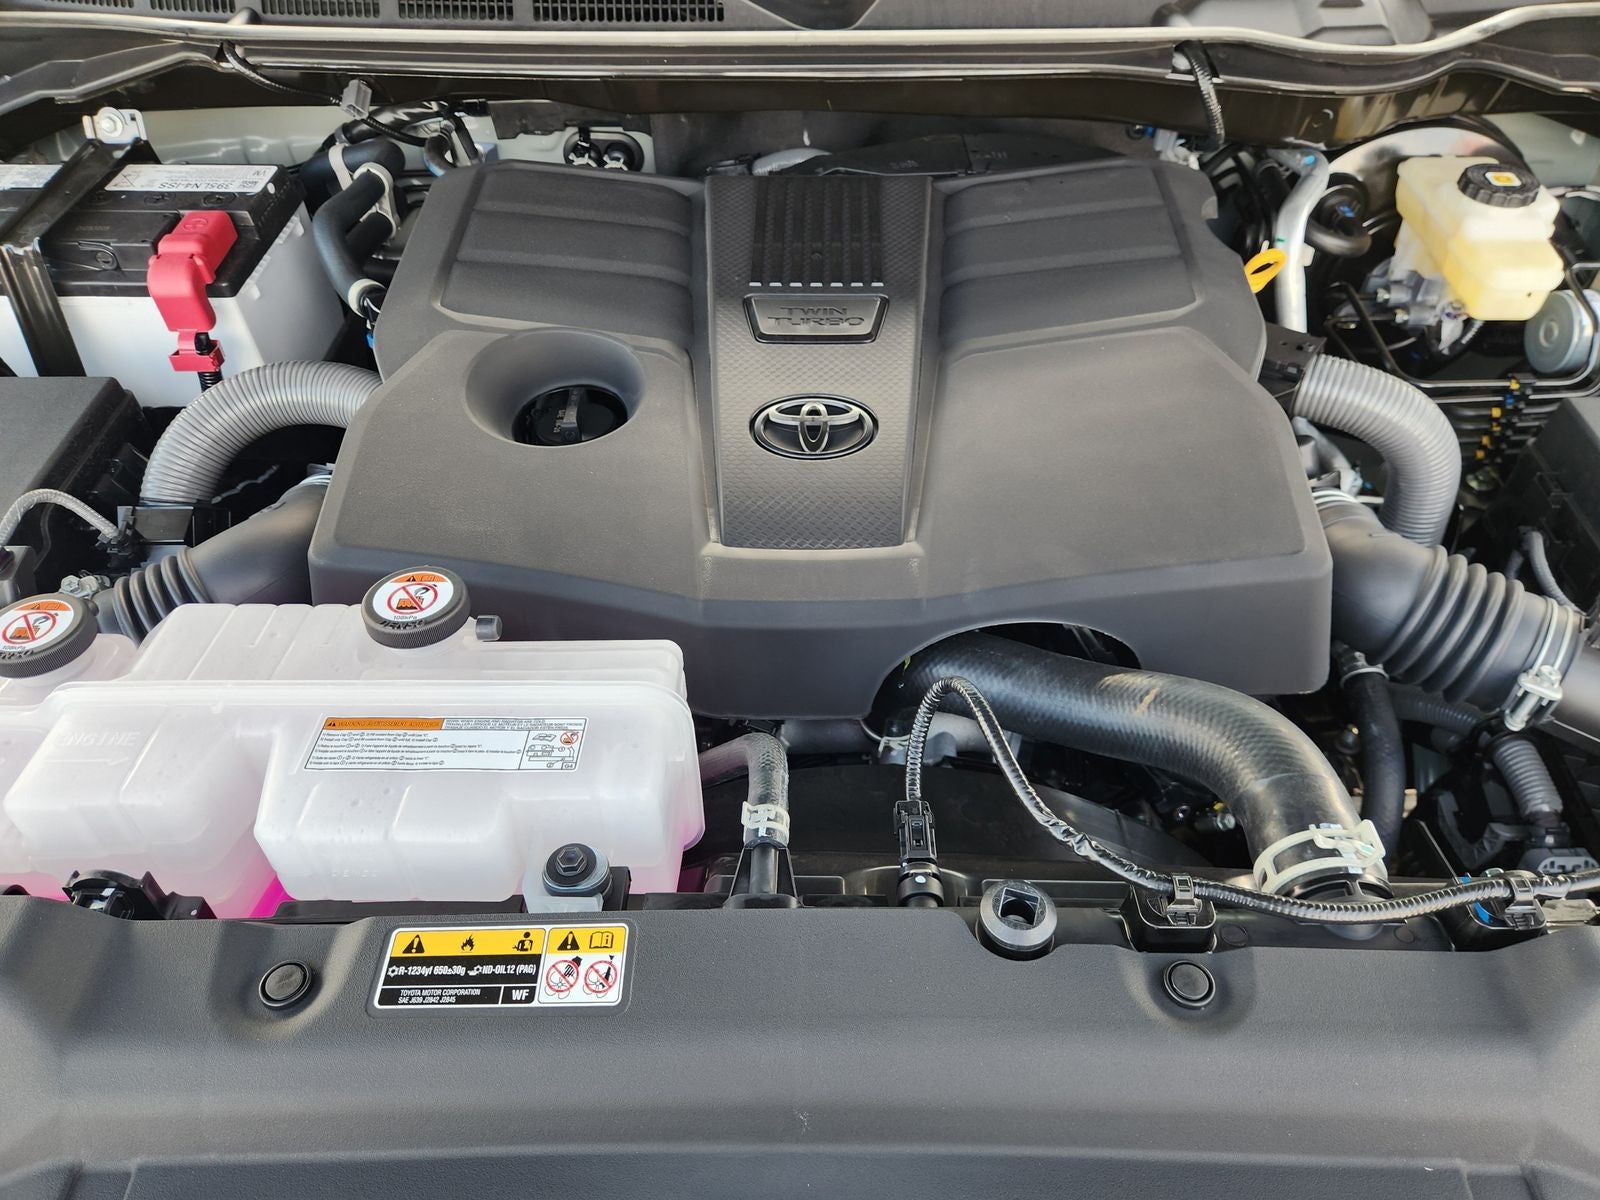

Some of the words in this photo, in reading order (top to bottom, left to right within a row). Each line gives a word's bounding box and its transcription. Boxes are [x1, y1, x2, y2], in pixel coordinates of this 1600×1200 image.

[780, 306, 848, 315] TWIN
[768, 316, 865, 326] TURBO
[56, 731, 141, 747] ENGINE
[398, 965, 433, 977] R-1234yf
[433, 965, 467, 977] 650±30g
[516, 964, 537, 976] (PAG)
[400, 989, 421, 997] TOYOTA
[442, 988, 481, 996] CORPORATION
[511, 988, 530, 1001] WF
[397, 996, 409, 1004] SAE
